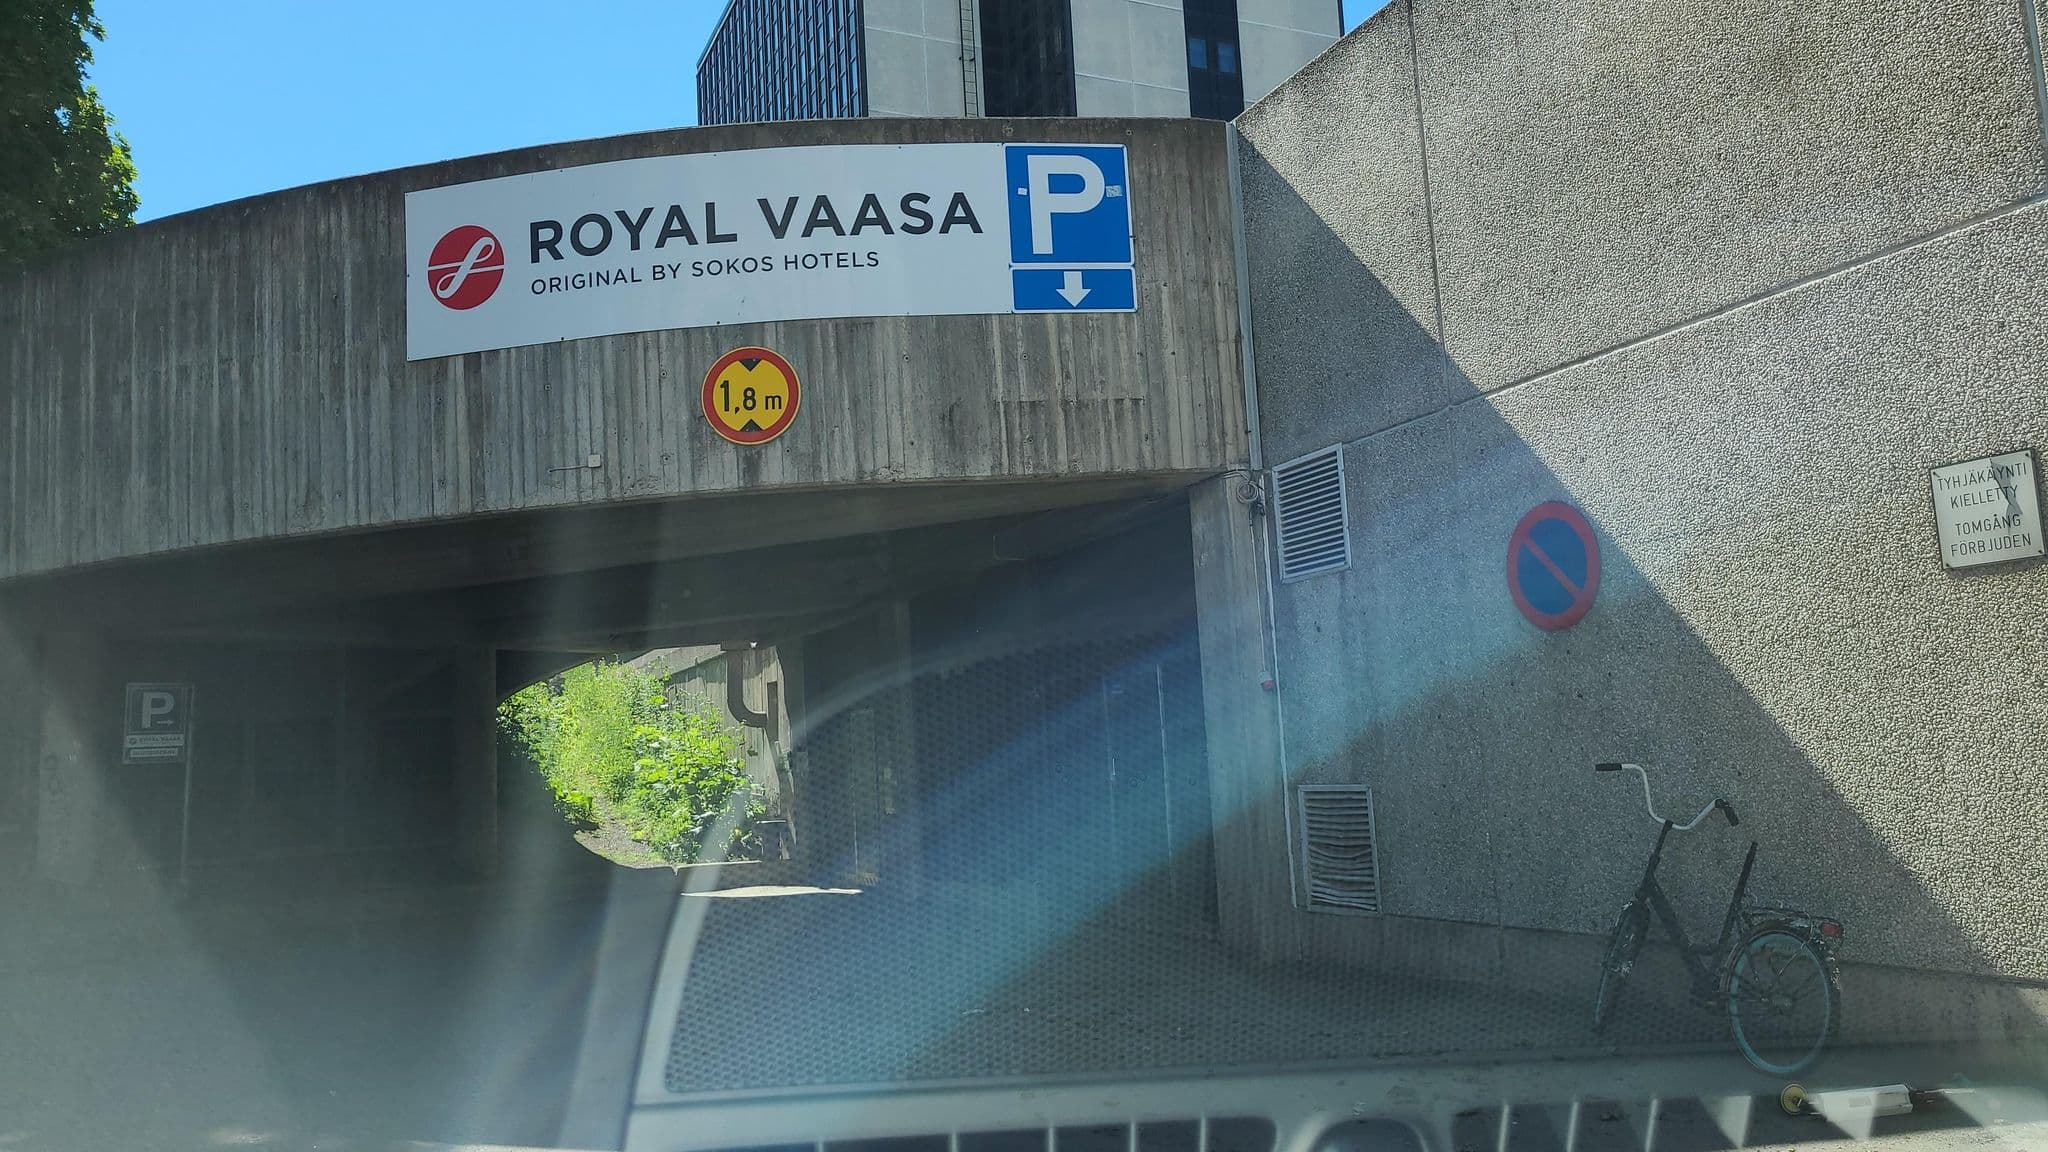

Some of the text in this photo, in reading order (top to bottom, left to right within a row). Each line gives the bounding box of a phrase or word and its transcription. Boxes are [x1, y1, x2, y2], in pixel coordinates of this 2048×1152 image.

[1027, 155, 1105, 254] P
[530, 192, 984, 264] ROYAL VAASA
[531, 252, 879, 294] ORIGINAL BY SOKOS HOTELS
[720, 380, 782, 414] 1,8 m
[1937, 462, 2027, 491] TYHJÄKÄYNTI
[1950, 484, 2018, 509] KIELLETTY
[1955, 513, 2021, 536] TOMGÅNG
[1950, 533, 2031, 557] FÖRBJUDEN
[142, 692, 175, 728] P
